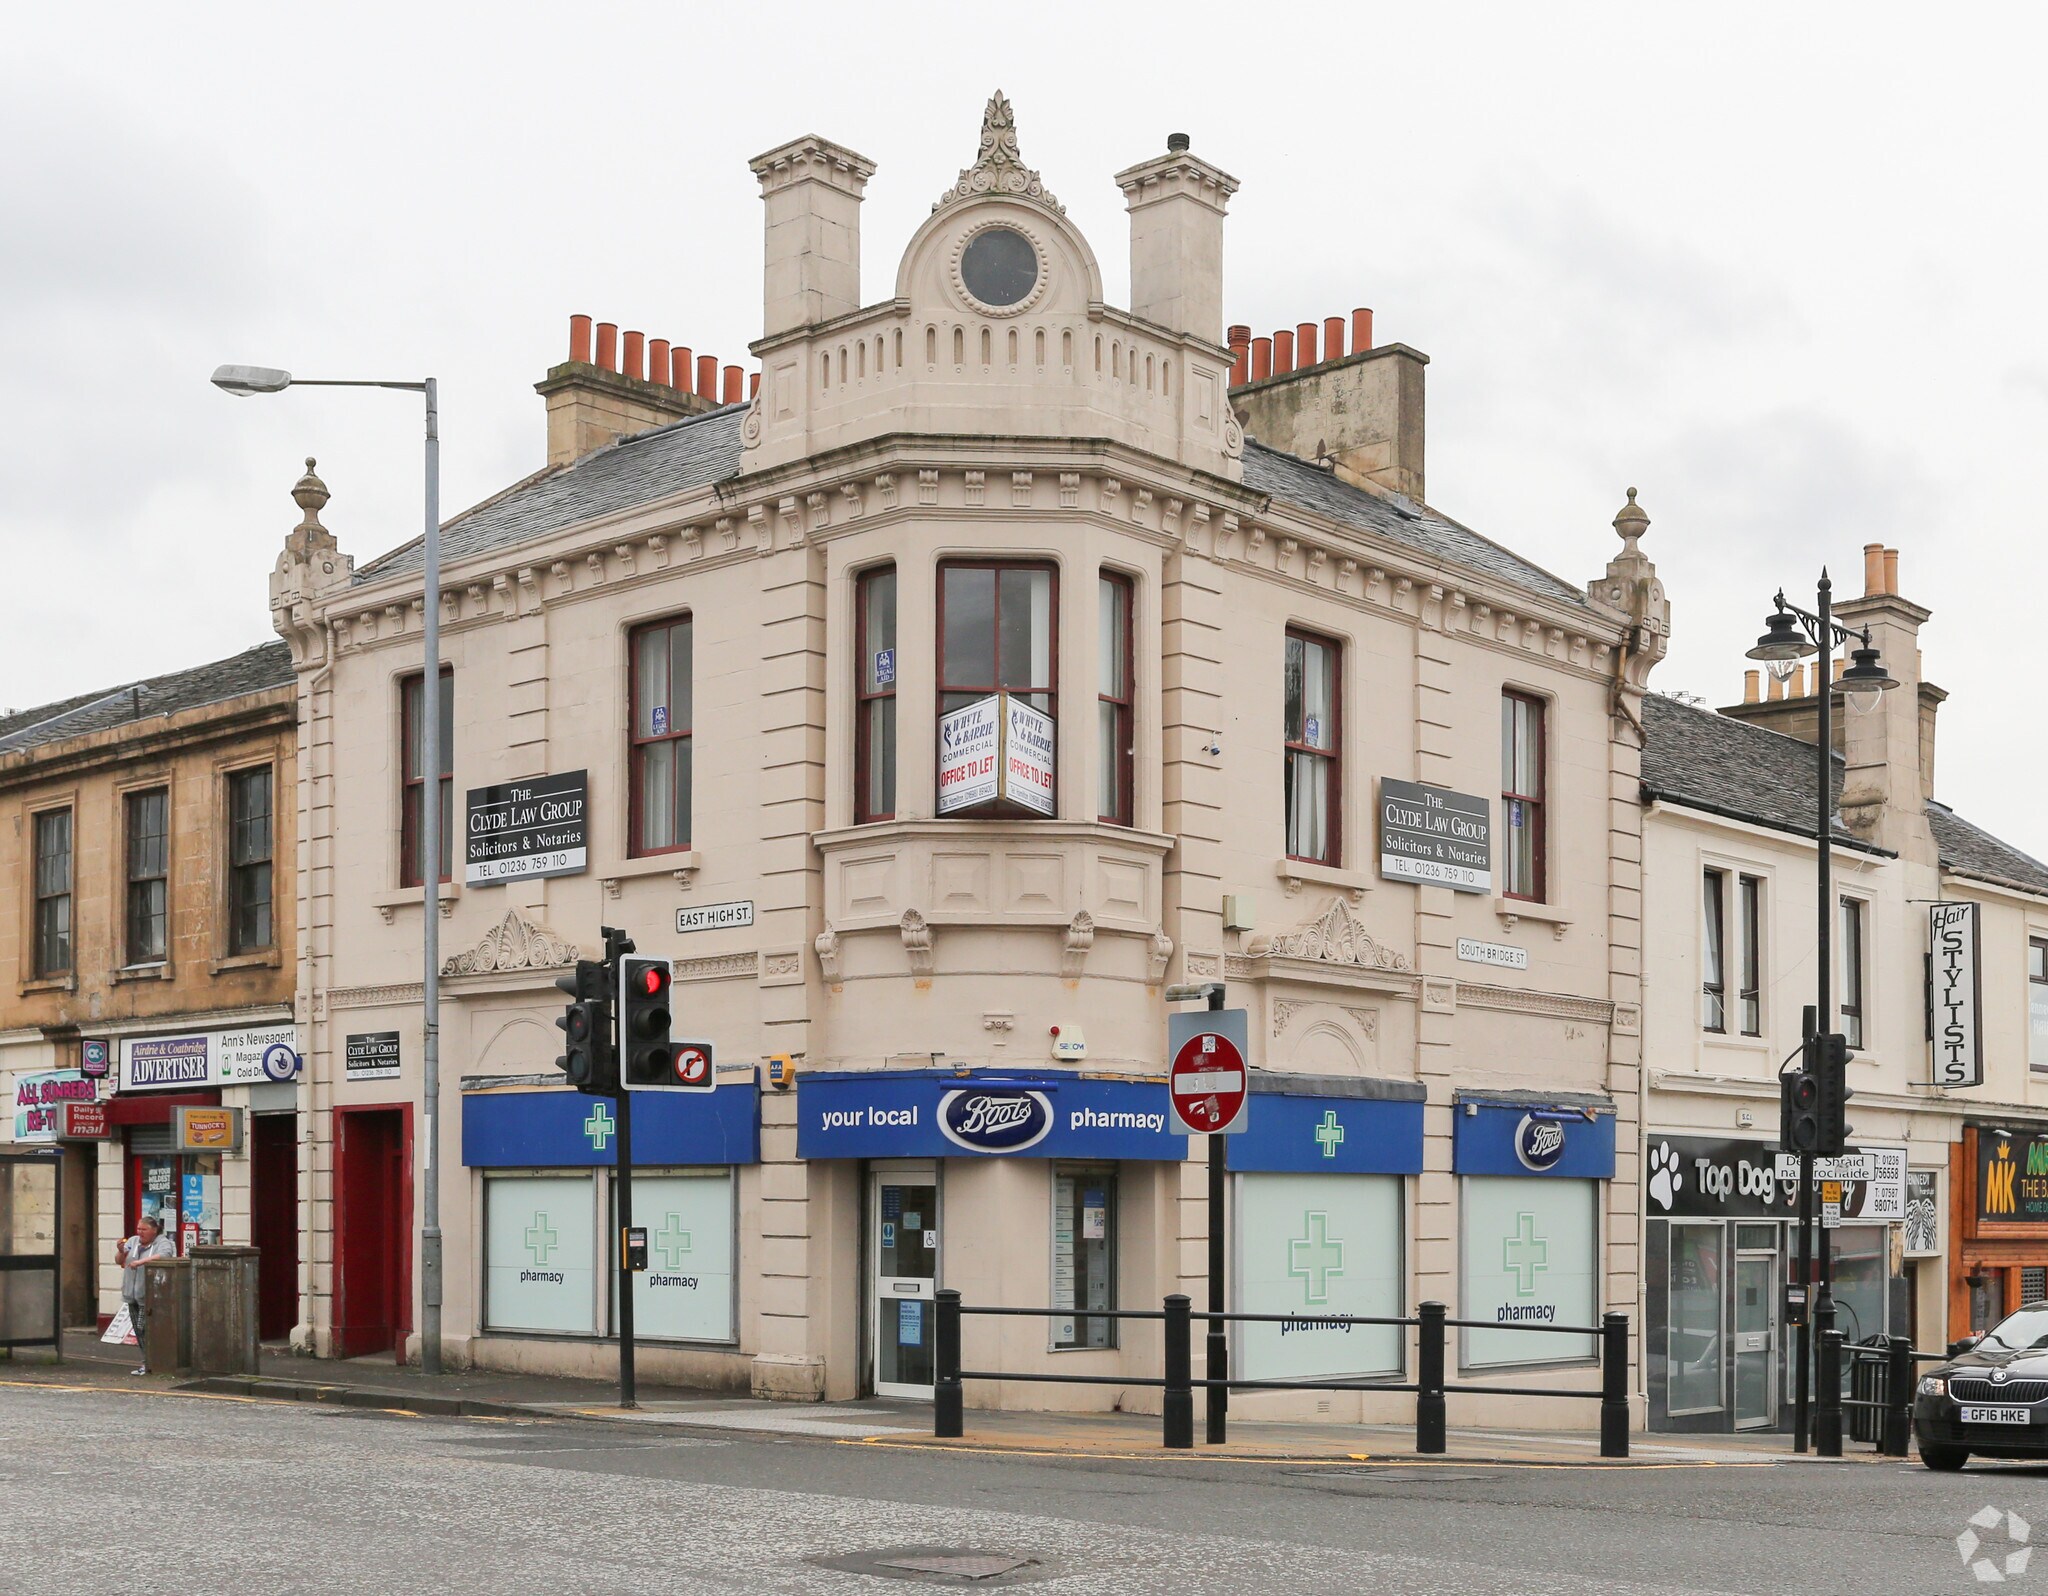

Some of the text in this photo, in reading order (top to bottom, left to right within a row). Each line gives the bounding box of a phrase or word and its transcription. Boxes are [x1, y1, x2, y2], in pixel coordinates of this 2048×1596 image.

[952, 709, 983, 732] WHYTE
[1019, 710, 1044, 734] WHYTE
[954, 720, 994, 746] & BARRIE
[1020, 728, 1051, 753] & BARRIE
[942, 740, 994, 764] COMMERCIAL
[1010, 740, 1051, 766] COMMERCIAL
[941, 756, 994, 788] OFFICE TO LET
[1009, 756, 1052, 789] OFFICE TO LET
[511, 788, 532, 802] THE
[1424, 793, 1443, 809] THE
[470, 800, 582, 832] CLYDE LAW GROUP
[1386, 804, 1422, 828] CLYDE
[1425, 811, 1448, 832] LAW
[1451, 816, 1486, 840] GROUP
[470, 830, 581, 858] Solicitors & Notaries
[1386, 834, 1486, 865] Solicitors & Notaries
[500, 860, 526, 874] 01236
[532, 856, 548, 870] 759
[552, 854, 566, 866] 110
[1414, 862, 1440, 877] 01236
[1444, 867, 1458, 880] 759
[1462, 870, 1474, 882] 110
[680, 908, 750, 926] EAST HIGH ST.
[1933, 906, 1969, 941] Hair
[1460, 944, 1524, 964] SOUTH BRIDGE ST
[1942, 930, 1966, 1082] STYLISTS
[134, 1042, 206, 1056] Airdrie & Coatbridge
[222, 1030, 294, 1048] Ann's Newsagent
[236, 1050, 262, 1064] Magazi
[348, 1044, 398, 1056] CLYDE LAW GROUP
[133, 1056, 206, 1082] ADVERTISER
[237, 1066, 264, 1078] Cold Dri
[17, 1083, 40, 1106] ALL
[27, 1110, 56, 1132] RE-T
[822, 1106, 918, 1131] your local
[956, 1096, 1032, 1134] Boots
[1070, 1107, 1164, 1133] pharmacy
[73, 1122, 104, 1134] mail
[1528, 1126, 1562, 1156] Boots
[1786, 1156, 1818, 1166] Des
[1882, 1154, 1900, 1166] 01236
[1695, 1158, 1734, 1202] Top
[1738, 1160, 1776, 1204] Dog
[1780, 1168, 1870, 1178] na rochaide
[1874, 1167, 1898, 1180] 756558
[1907, 1174, 1930, 1186] ENNEDY
[1874, 1188, 1898, 1198] T: 07587
[1986, 1160, 2016, 1214] MK
[2021, 1179, 2048, 1198] THE B
[1874, 1200, 1898, 1212] 980714
[2026, 1202, 2042, 1212] HOME
[520, 1269, 564, 1284] pharmacy
[650, 1274, 698, 1290] pharmacy
[1498, 1302, 1556, 1322] pharmacy
[1972, 1409, 1998, 1420] GF16
[2000, 1410, 2025, 1422] HKE
